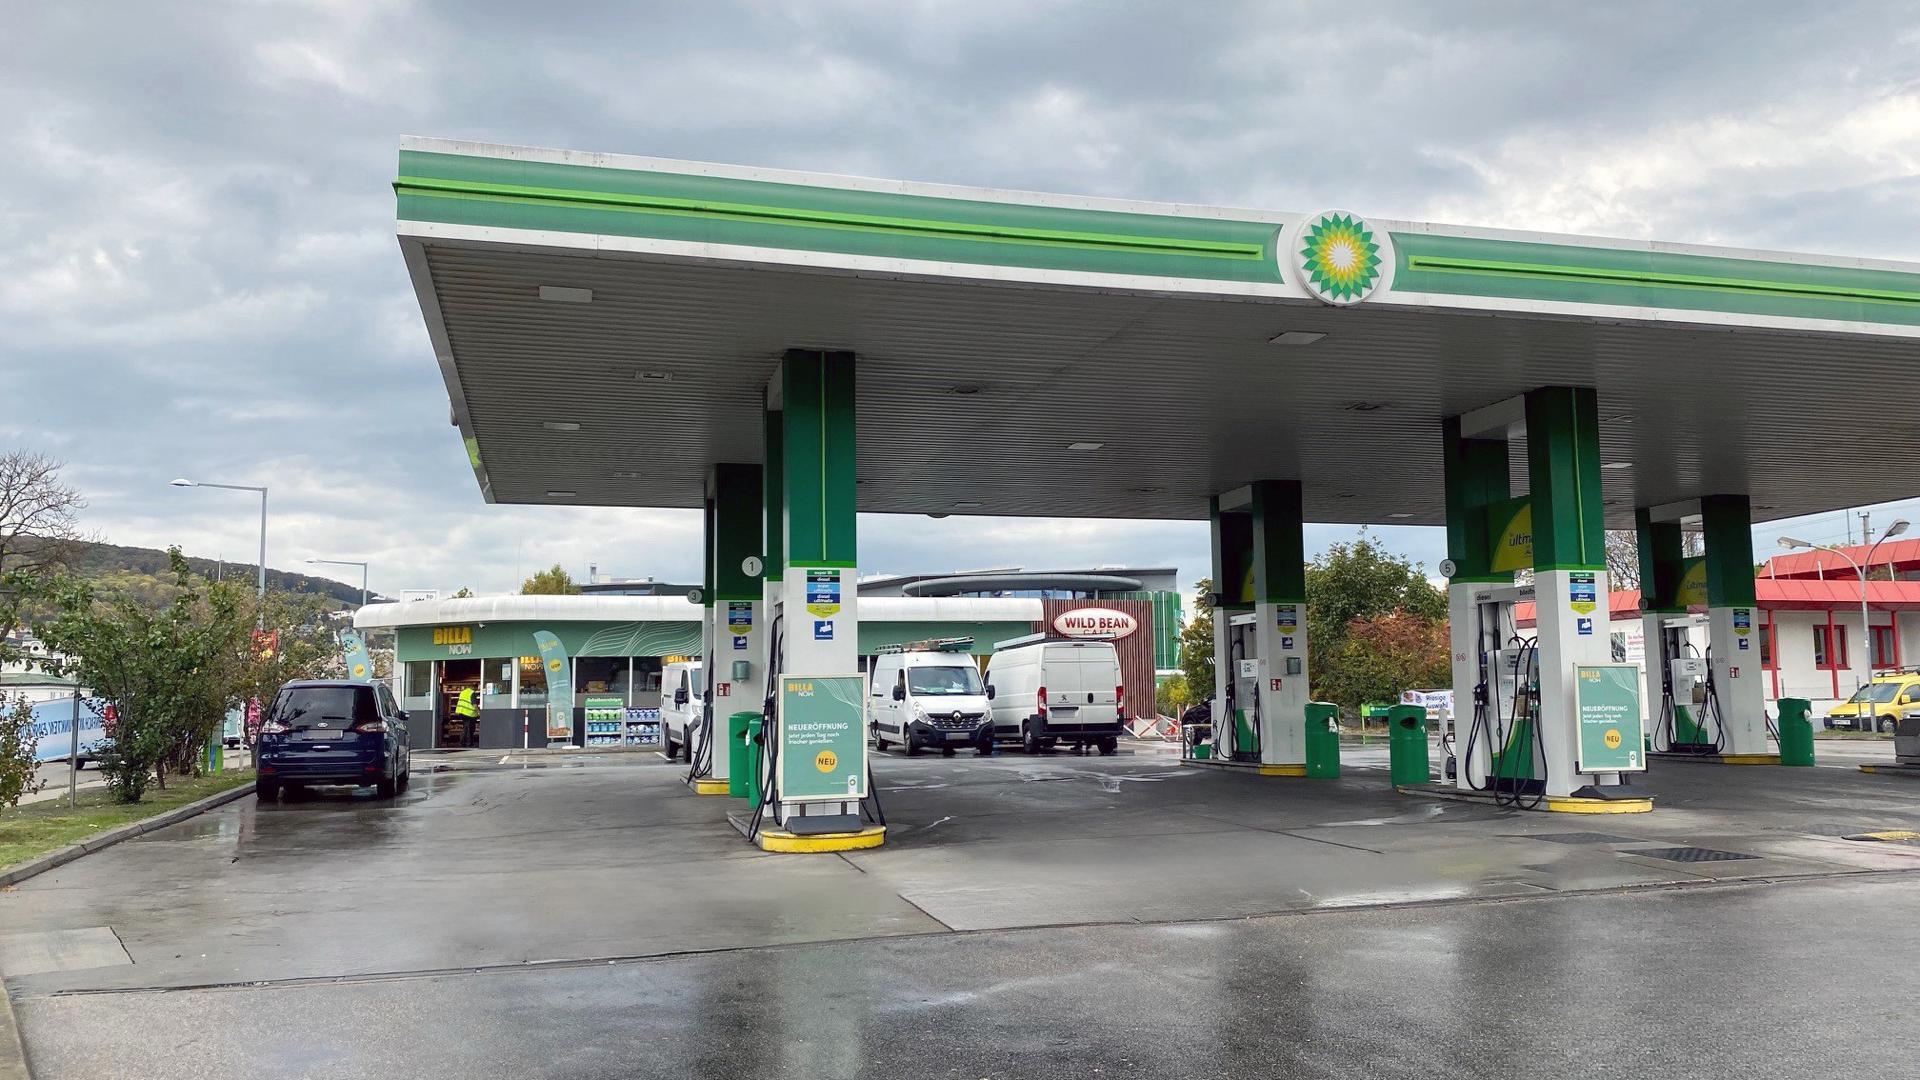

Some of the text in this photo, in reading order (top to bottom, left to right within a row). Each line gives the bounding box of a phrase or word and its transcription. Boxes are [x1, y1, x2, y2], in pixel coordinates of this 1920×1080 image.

[749, 561, 754, 572] 1
[1444, 564, 1451, 573] 5
[690, 592, 697, 601] 3
[1477, 592, 1492, 601] diesel
[1064, 617, 1130, 629] WILD BEAN
[433, 626, 472, 645] BILLA
[448, 644, 472, 656] NOW
[787, 683, 814, 692] BILLA
[788, 722, 849, 731] NEUERÖFFNUNG
[816, 732, 826, 741] Tag
[817, 758, 836, 766] NEU
